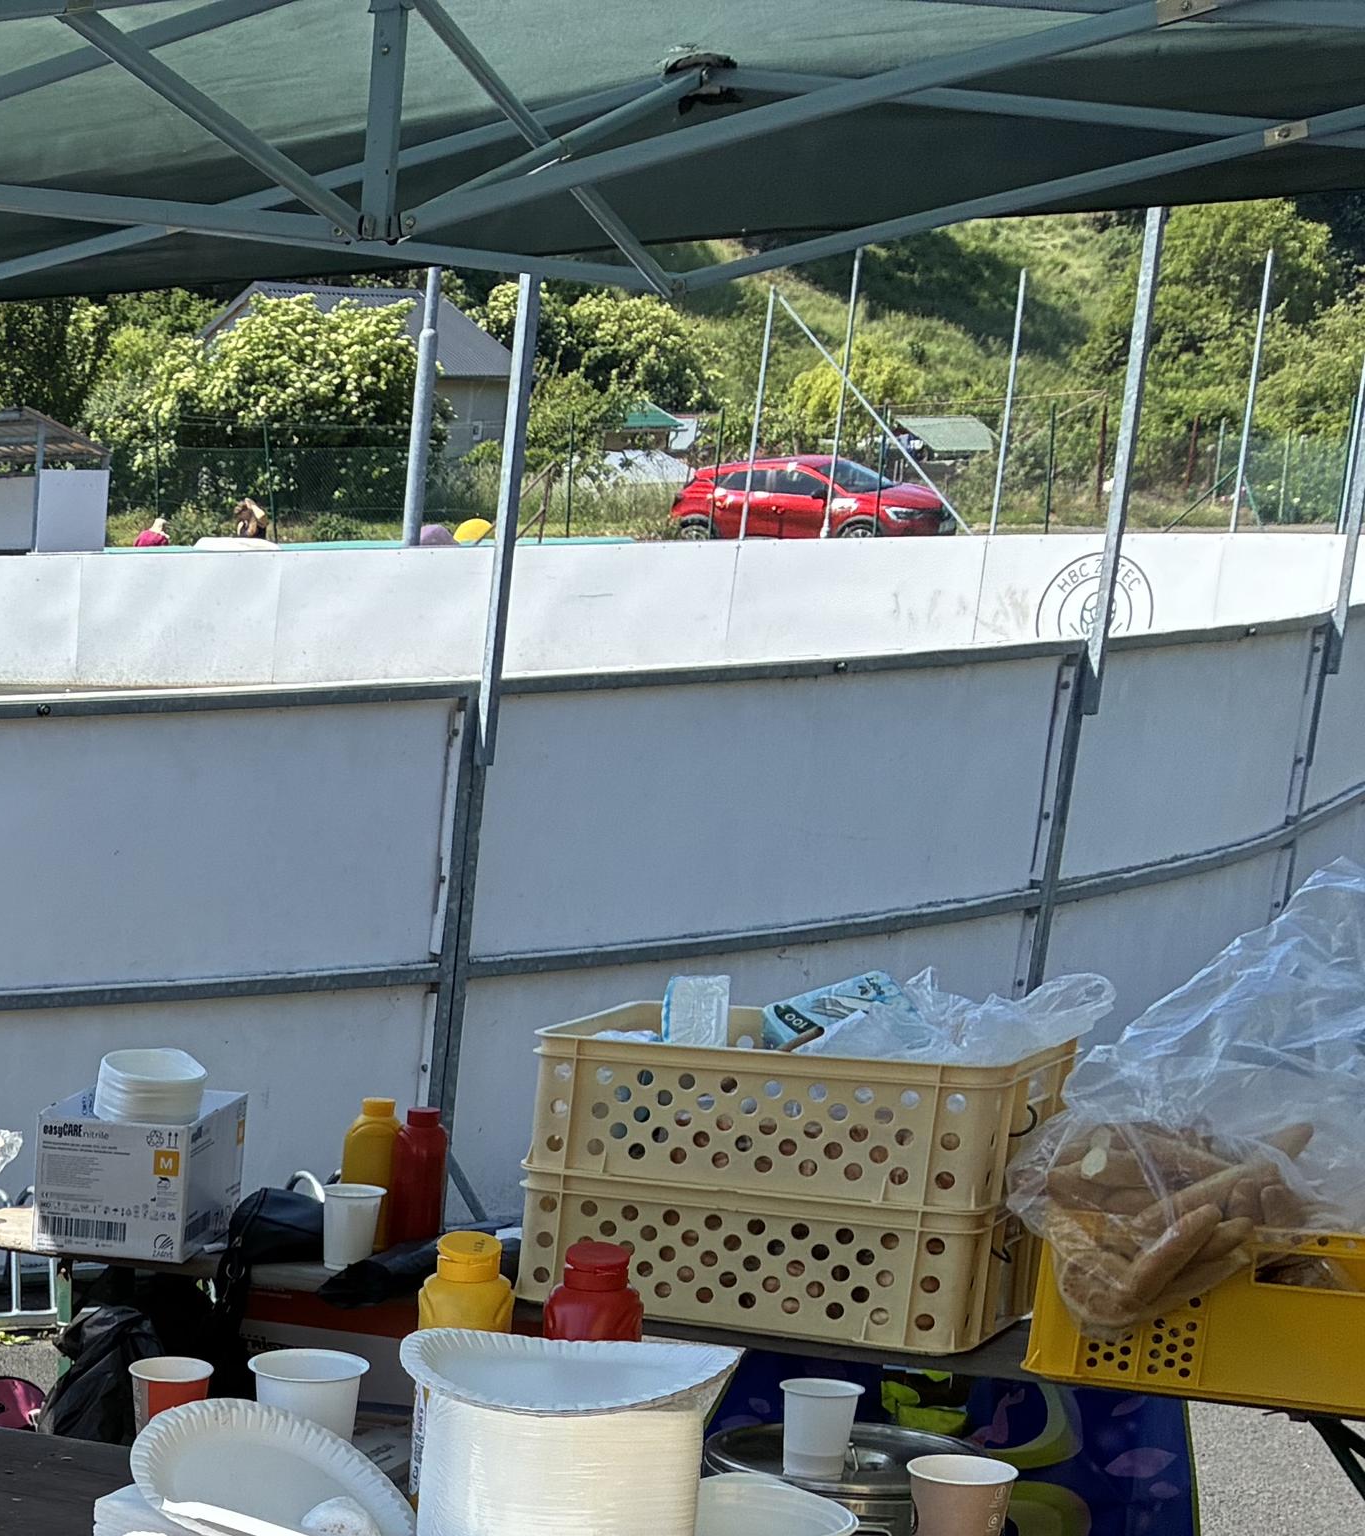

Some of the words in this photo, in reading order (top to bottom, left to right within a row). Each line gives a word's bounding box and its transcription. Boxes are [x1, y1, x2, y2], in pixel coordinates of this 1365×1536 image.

[1057, 563, 1089, 593] HBC
[43, 1123, 83, 1138] easyCARE
[83, 1130, 109, 1140] nitrile
[160, 1157, 173, 1170] M
